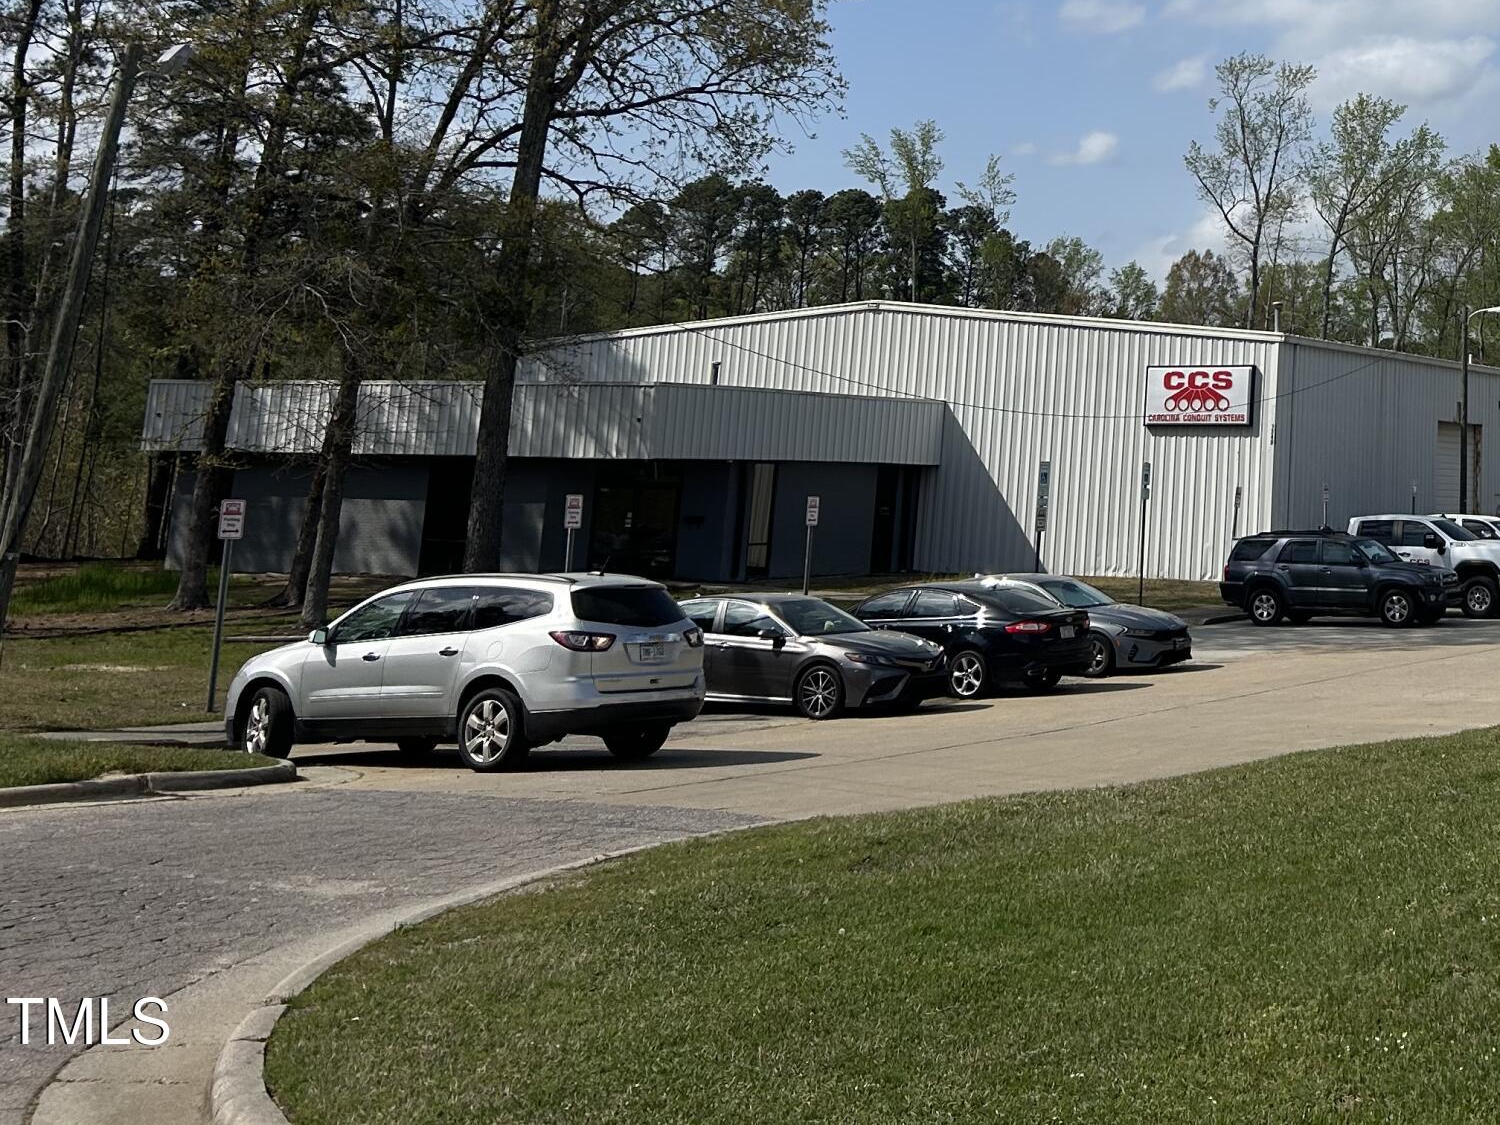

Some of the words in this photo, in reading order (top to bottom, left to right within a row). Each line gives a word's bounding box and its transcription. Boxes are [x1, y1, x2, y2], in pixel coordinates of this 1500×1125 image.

[1163, 370, 1233, 390] CCS
[1148, 413, 1180, 422] CAROLINA
[1182, 413, 1212, 422] CONDUIT
[1214, 413, 1245, 422] SYSTEMS
